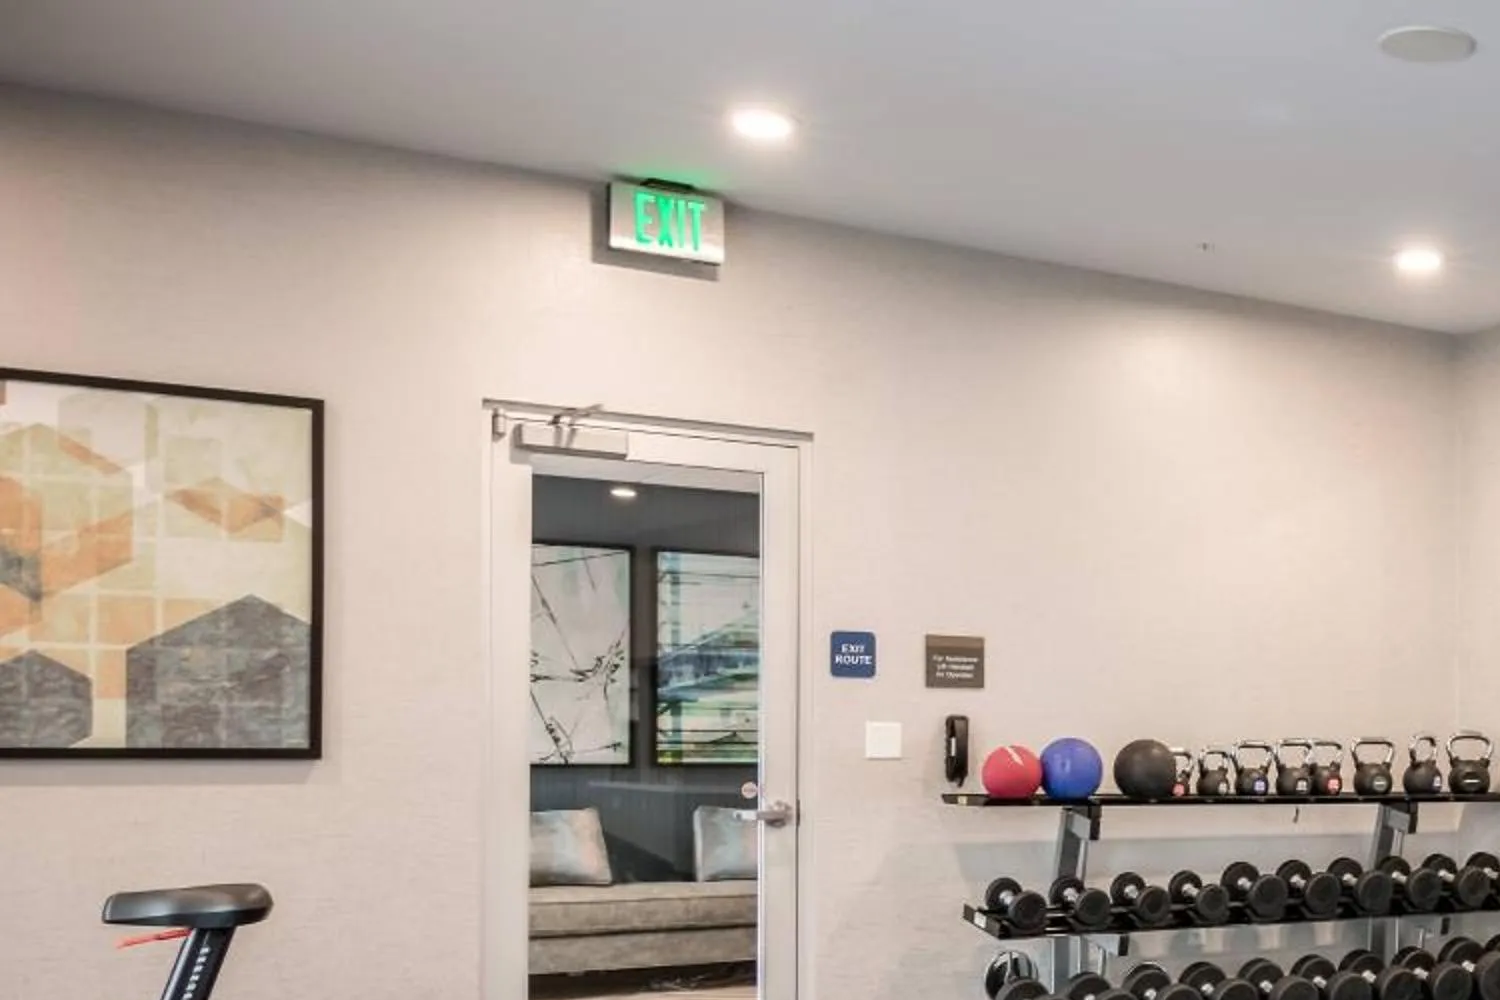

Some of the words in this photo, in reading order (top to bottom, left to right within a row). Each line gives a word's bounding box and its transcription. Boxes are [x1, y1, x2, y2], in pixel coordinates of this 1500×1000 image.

[634, 190, 706, 251] EXIT
[841, 643, 865, 653] EXIT
[835, 655, 873, 665] ROUTE
